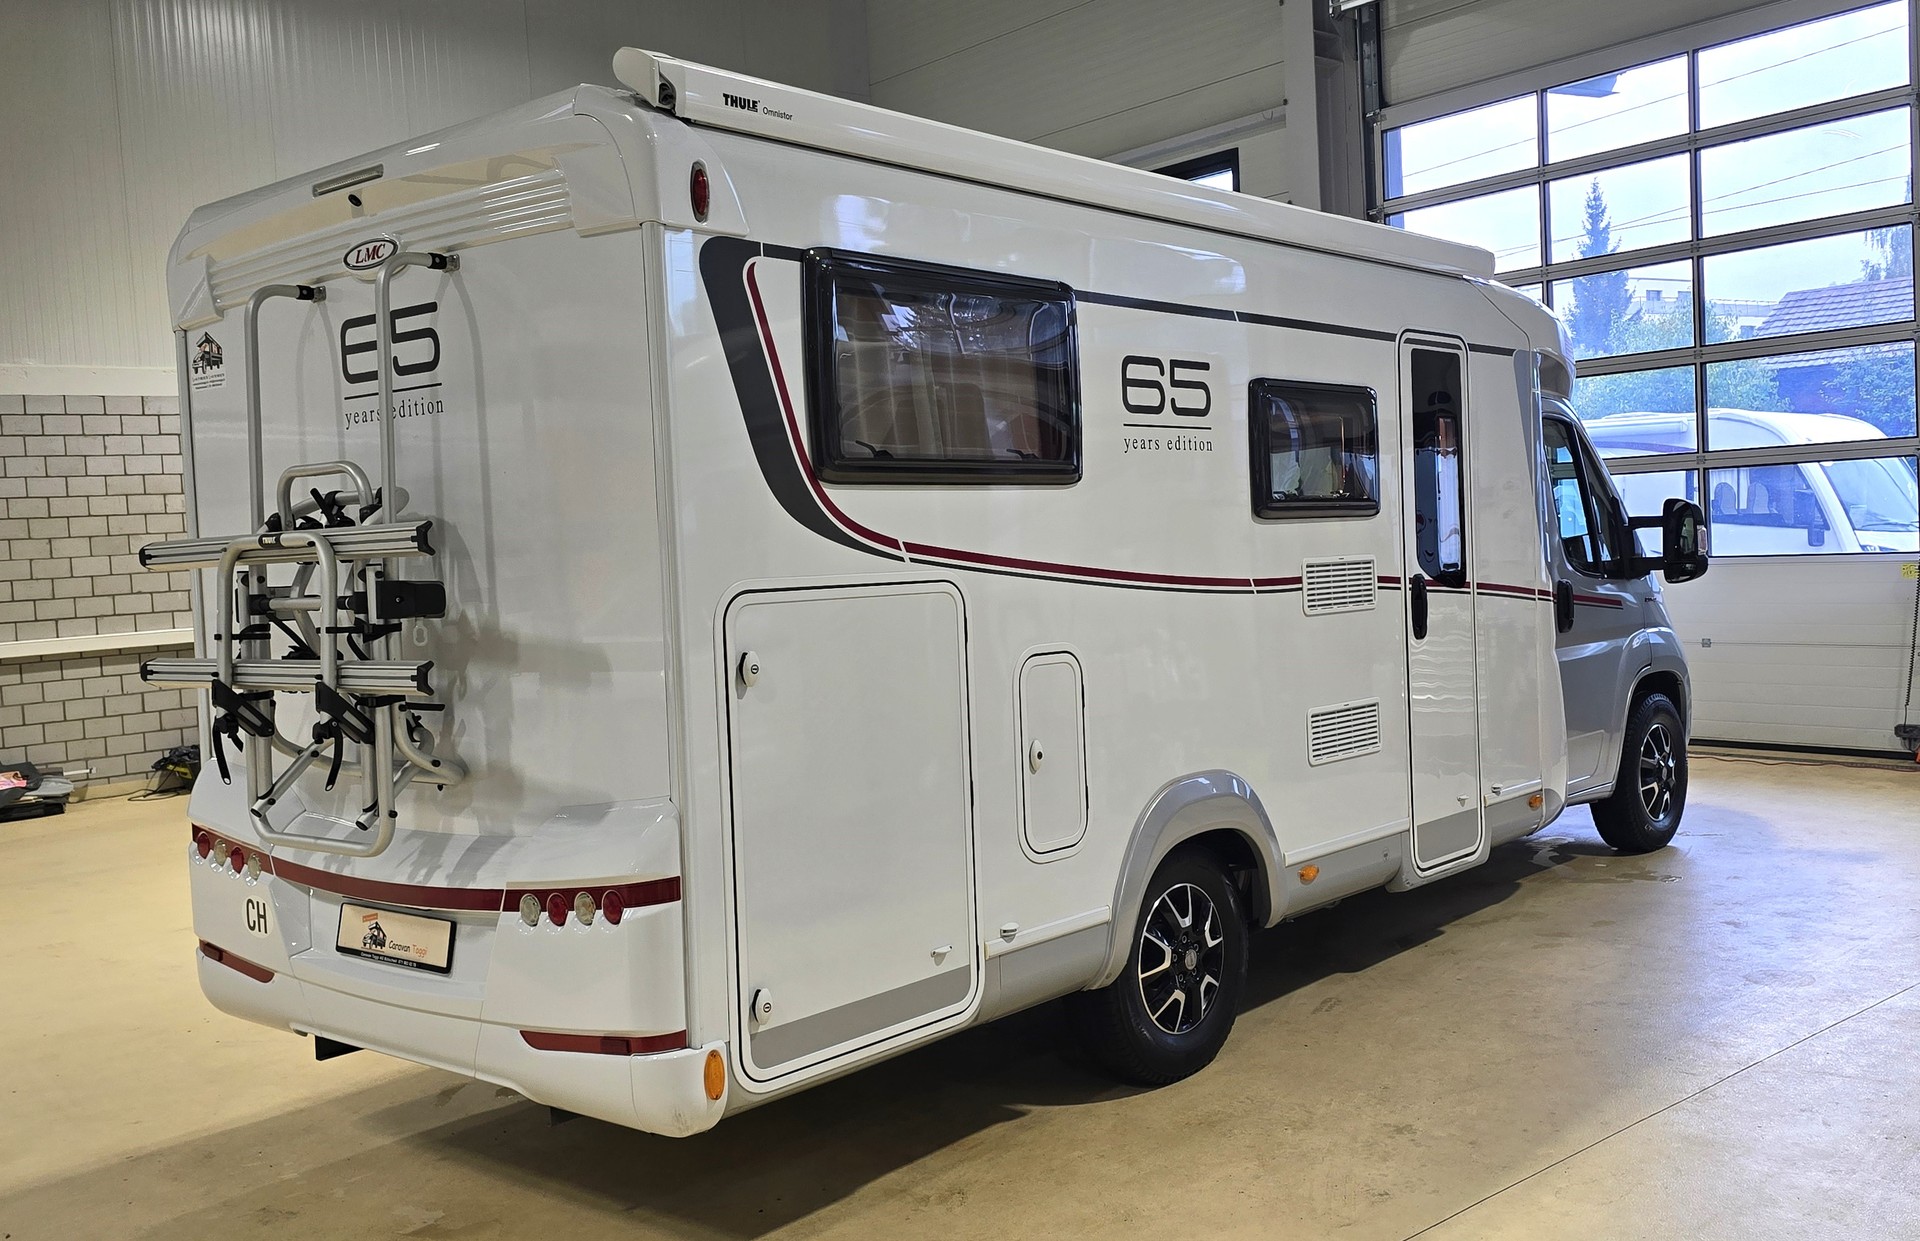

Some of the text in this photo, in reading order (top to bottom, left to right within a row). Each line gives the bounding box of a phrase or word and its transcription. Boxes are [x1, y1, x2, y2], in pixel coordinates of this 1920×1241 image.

[722, 93, 793, 120] THULE Omnistor
[355, 243, 386, 264] LMC
[1121, 355, 1211, 417] 65
[1124, 435, 1213, 453] years edition
[246, 898, 268, 934] CH
[388, 940, 428, 958] Caravan Toggi
